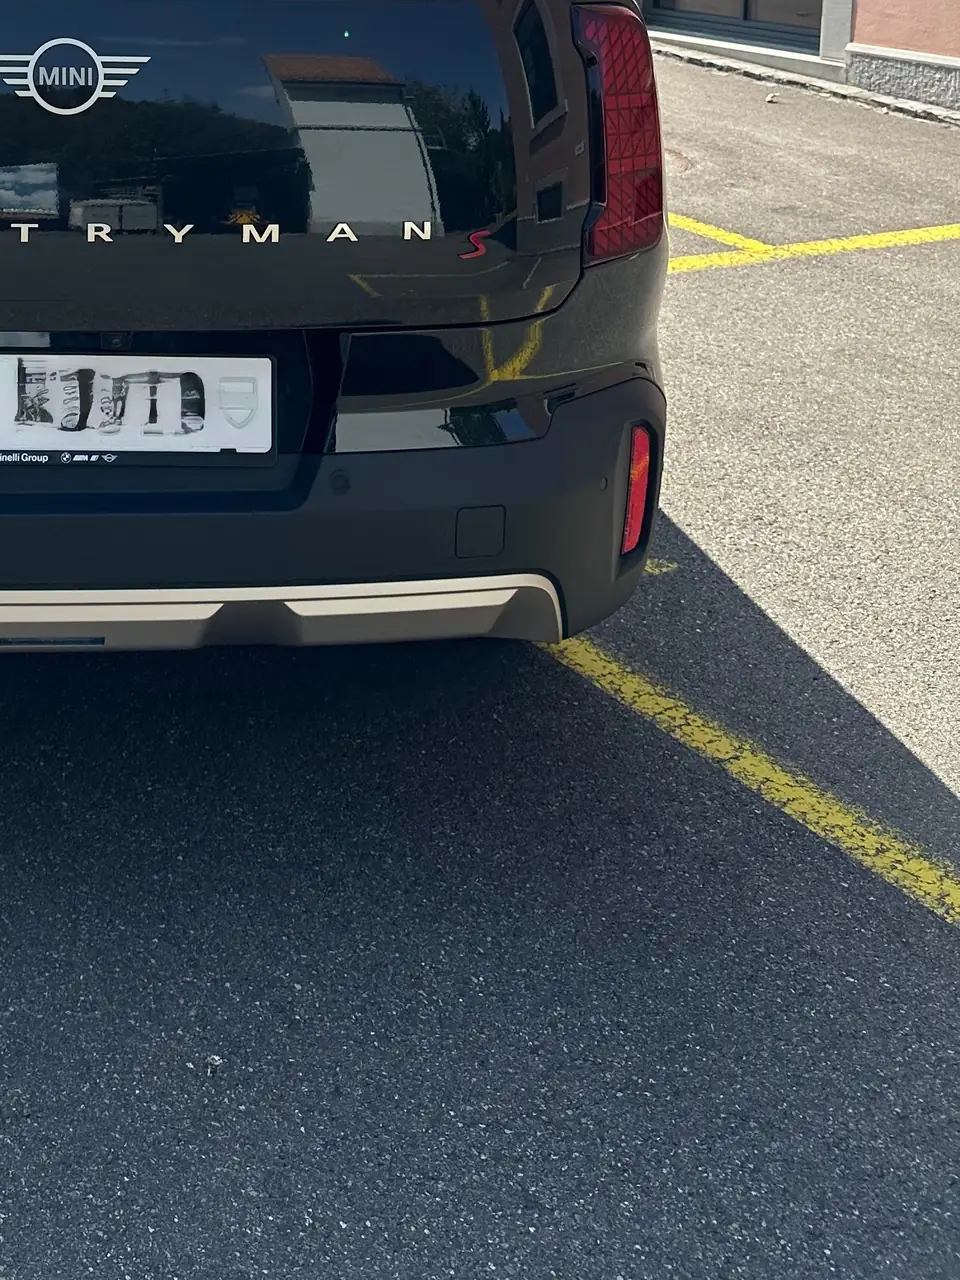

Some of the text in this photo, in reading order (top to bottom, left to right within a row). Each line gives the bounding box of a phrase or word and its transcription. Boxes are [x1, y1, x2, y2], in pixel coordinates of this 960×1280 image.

[39, 66, 93, 86] MINI
[459, 230, 486, 259] S
[21, 453, 49, 463] Group
